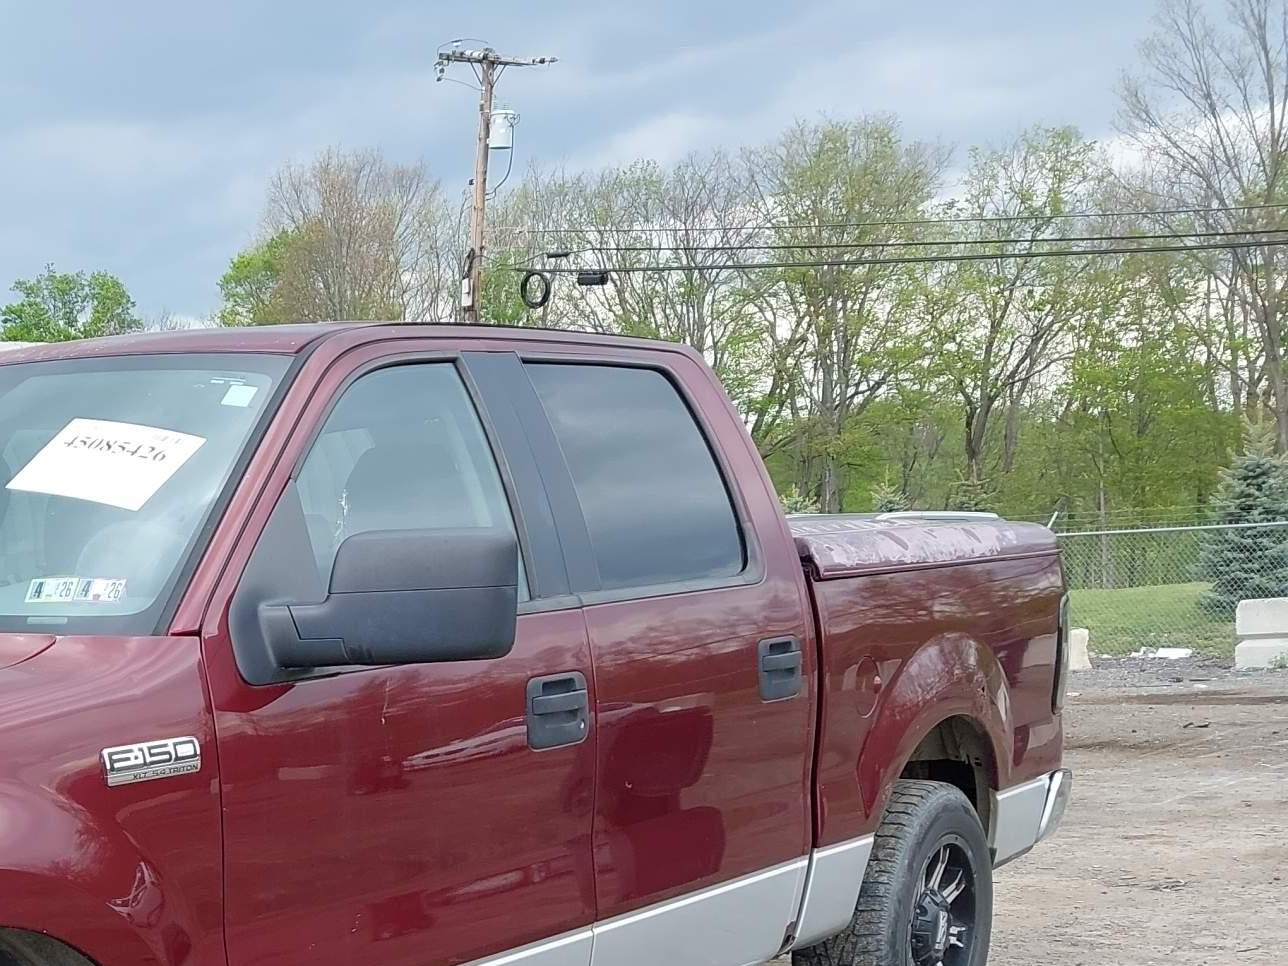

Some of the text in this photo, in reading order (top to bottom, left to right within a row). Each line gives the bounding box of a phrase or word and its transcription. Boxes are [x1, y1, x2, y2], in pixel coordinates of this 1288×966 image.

[64, 435, 166, 461] 45085426
[59, 581, 74, 599] 26
[107, 582, 123, 599] 26
[107, 739, 198, 772] F-150
[167, 763, 199, 776] TRITON
